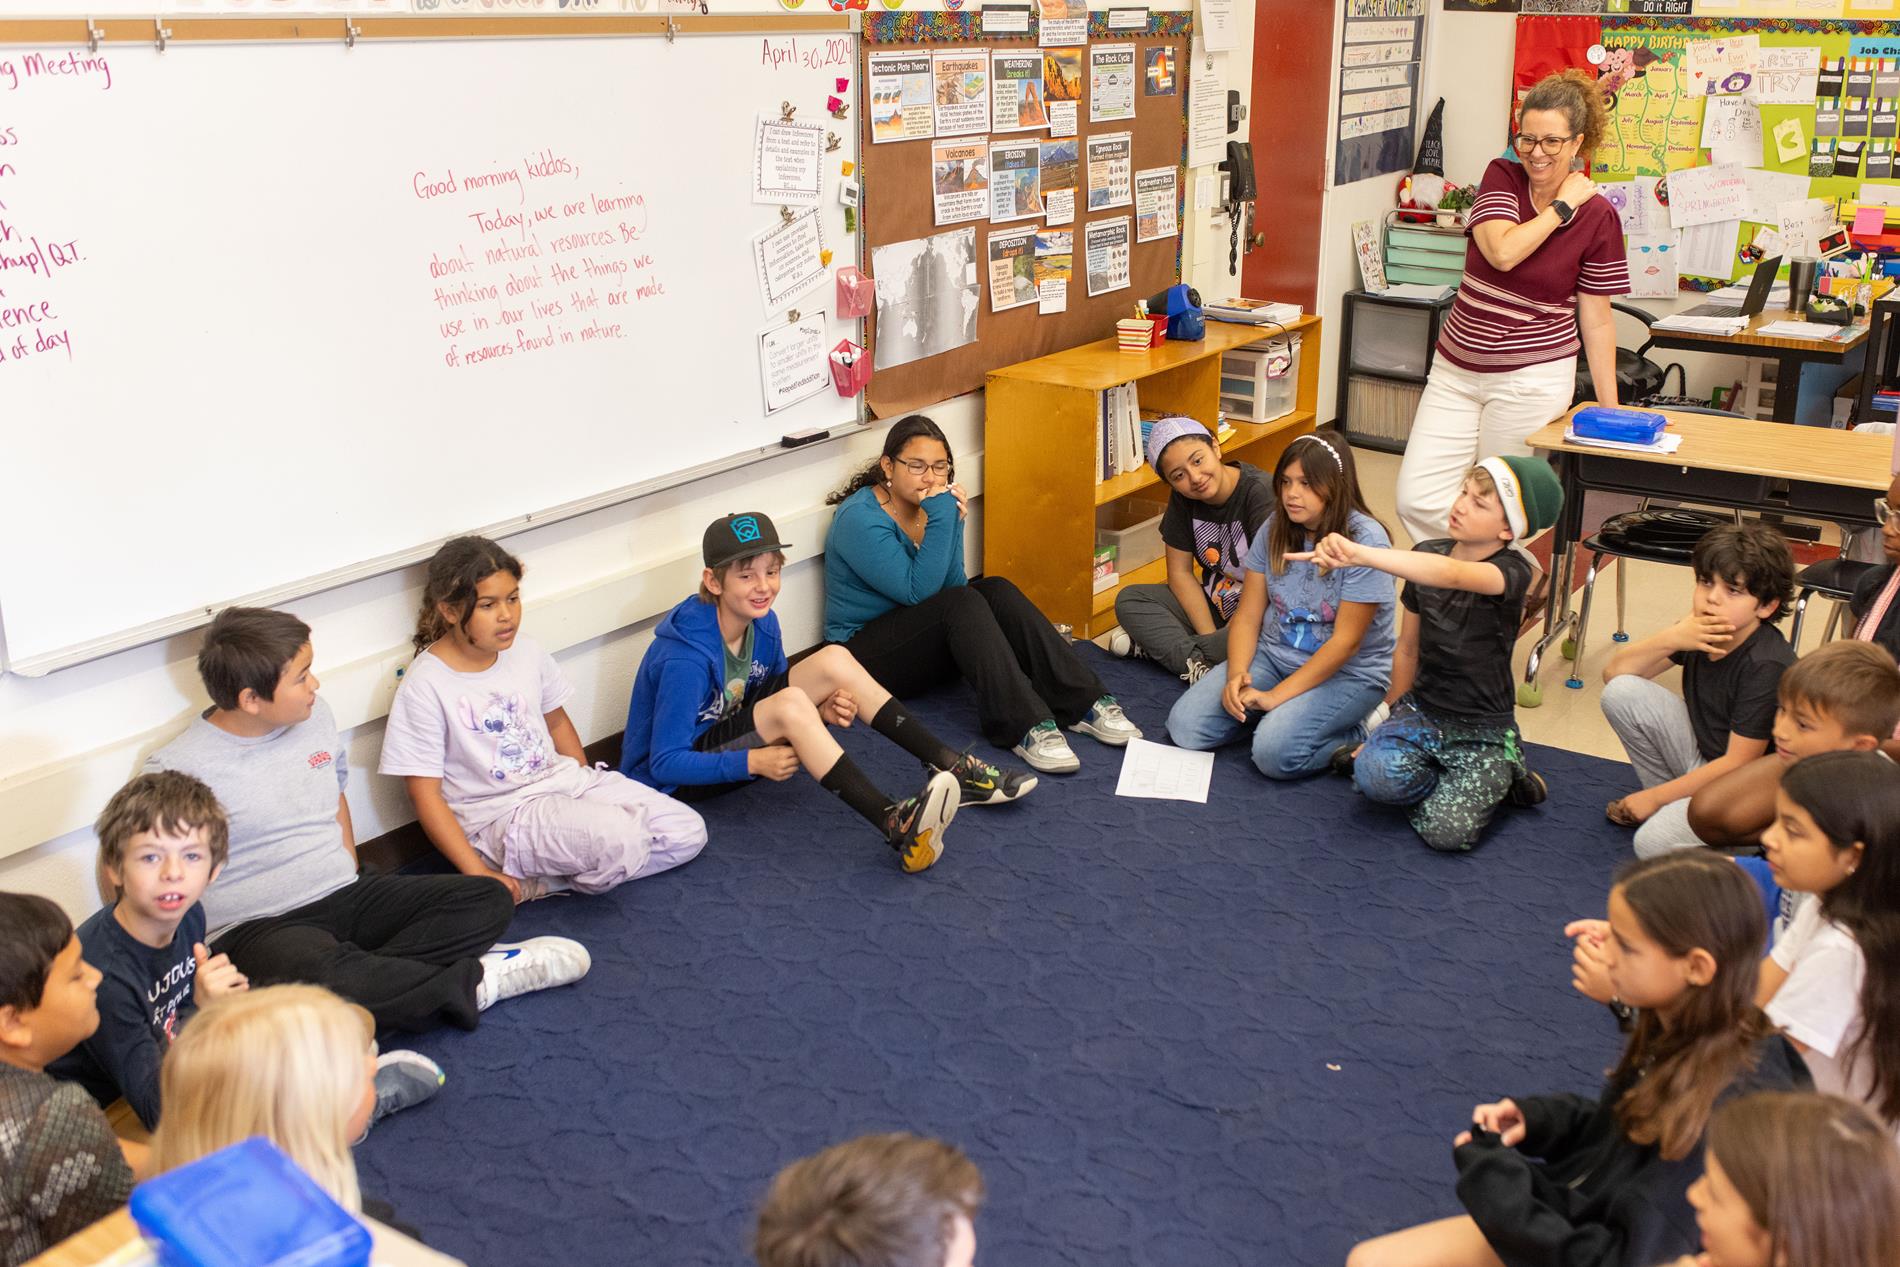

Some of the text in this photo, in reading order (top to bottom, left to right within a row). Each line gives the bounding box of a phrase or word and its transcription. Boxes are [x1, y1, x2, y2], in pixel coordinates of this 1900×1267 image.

[1644, 2, 1654, 12] DO
[1666, 2, 1688, 13] RIGHT
[1604, 35, 1645, 48] HAPPY
[762, 37, 853, 70] April 30, 2024
[1860, 46, 1879, 55] Job
[1004, 60, 1032, 68] WEATHERING
[1096, 54, 1130, 63] The Rock Cycle
[22, 51, 112, 90] Meeting
[872, 62, 929, 73] Tectonic Plate Theory
[942, 61, 978, 71] Earthquakes
[1720, 99, 1738, 107] Have
[945, 149, 976, 159] Volcanoes
[1005, 150, 1026, 159] EROSION
[1095, 144, 1112, 154] Igneous
[413, 148, 579, 206] Good morning kiddos,
[1139, 178, 1163, 187] Sedimentary
[468, 182, 648, 242] Today, we are learning
[1088, 227, 1126, 240] Metamorphic Rock
[999, 238, 1027, 249] DEPOSITION
[430, 222, 641, 279] about natural resources. Be
[433, 253, 654, 321] thinking about the things we
[440, 275, 666, 338] use in our lives that are made
[12, 335, 28, 360] of
[36, 328, 73, 363] day
[445, 319, 627, 367] of resources found in nature.
